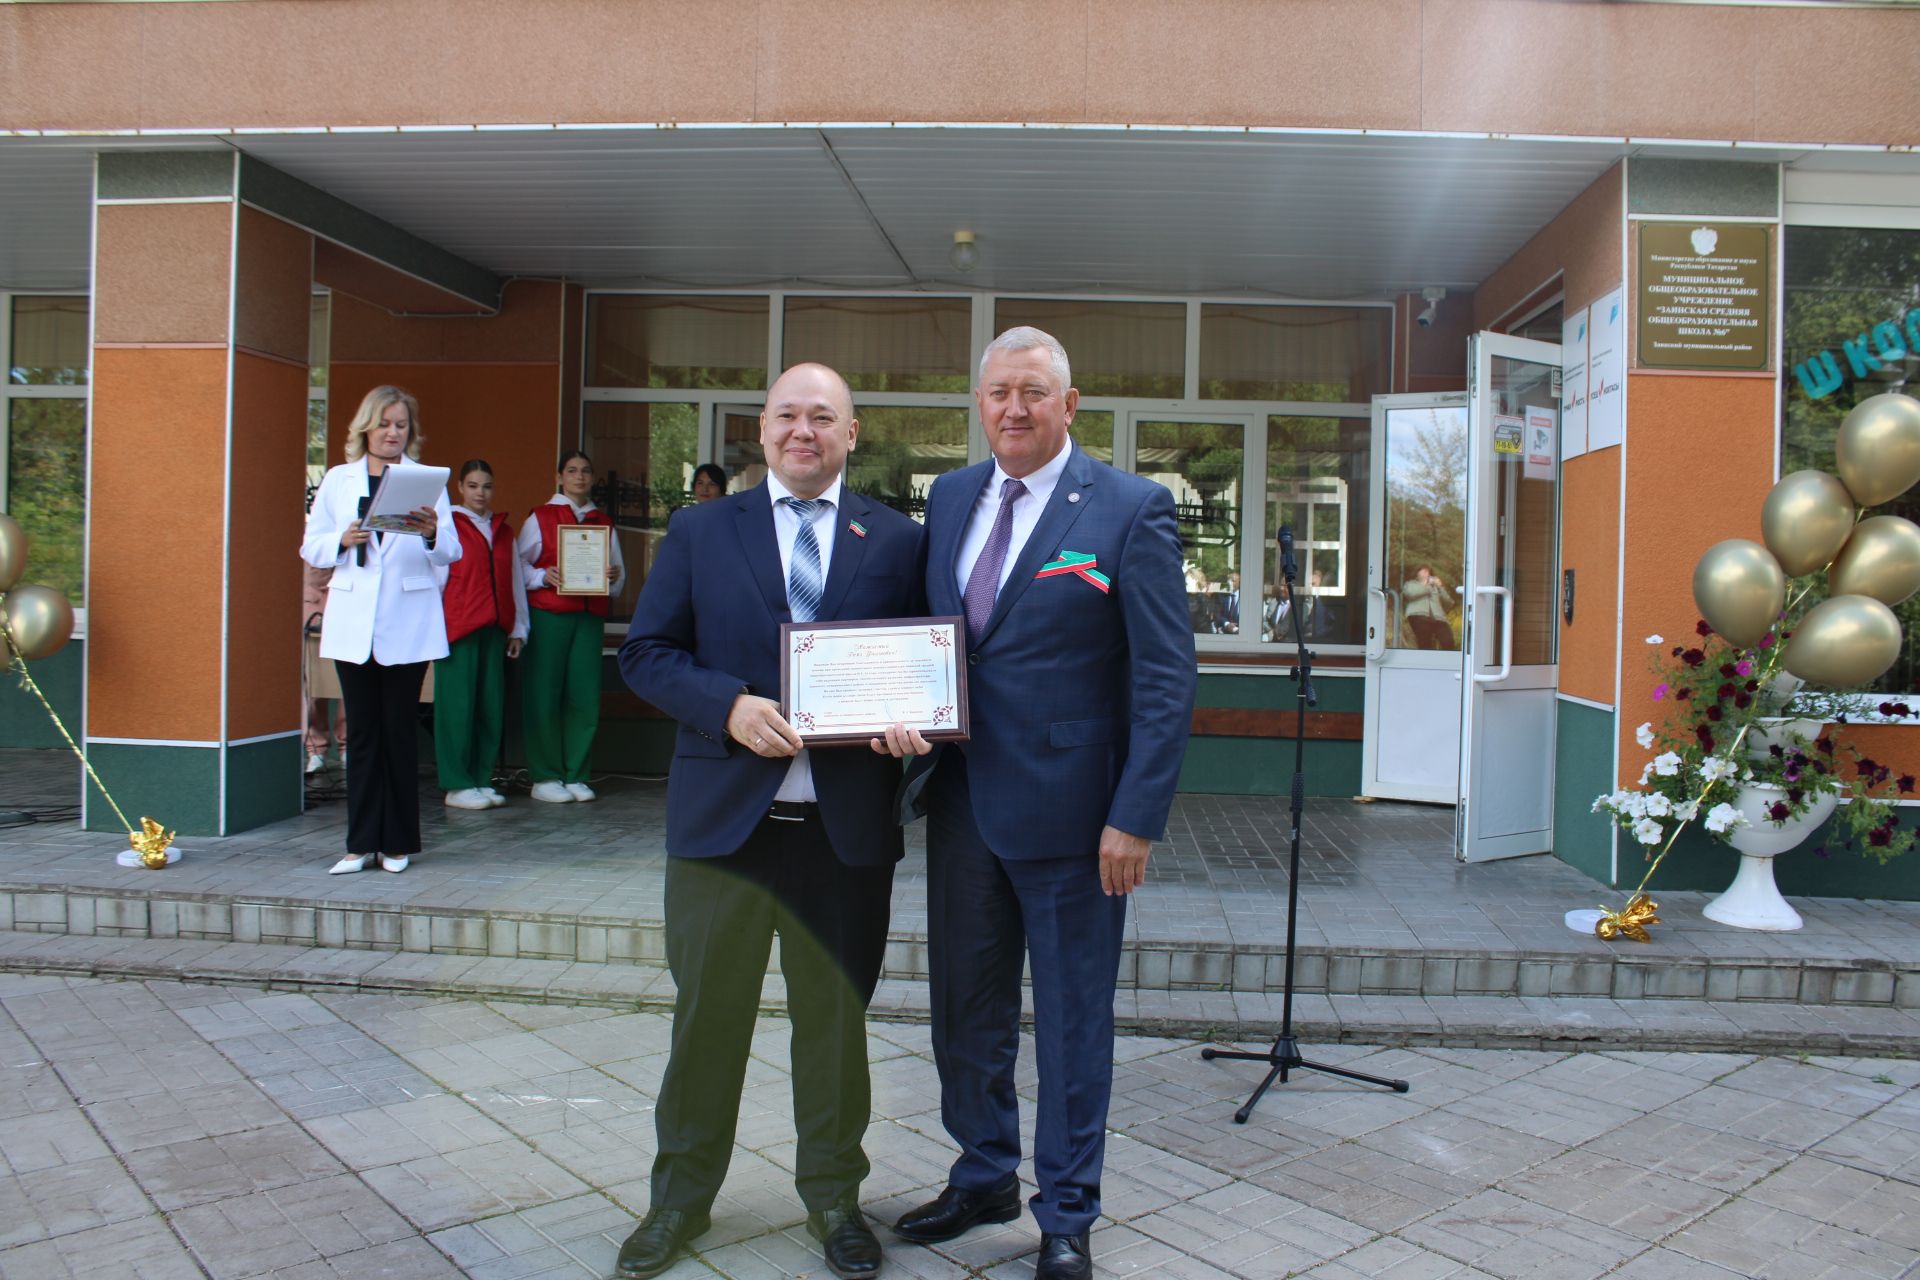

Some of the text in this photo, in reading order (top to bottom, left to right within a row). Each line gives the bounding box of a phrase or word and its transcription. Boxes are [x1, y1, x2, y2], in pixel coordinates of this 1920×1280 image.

[1663, 275, 1745, 285] МУНИЦИПАЛЬНОЕ
[1648, 285, 1759, 296] ОБЩЕОБРАЗОВАТЕЛЬНОЕ
[1673, 296, 1734, 305] УЧРЕЖДЕНИЕ
[1709, 307, 1750, 316] СРЕДНЯЯ
[1648, 316, 1758, 326] ОБЩЕОБРАЗОВАТЕЛЬНАЯ
[1678, 327, 1711, 336] ШКОЛА
